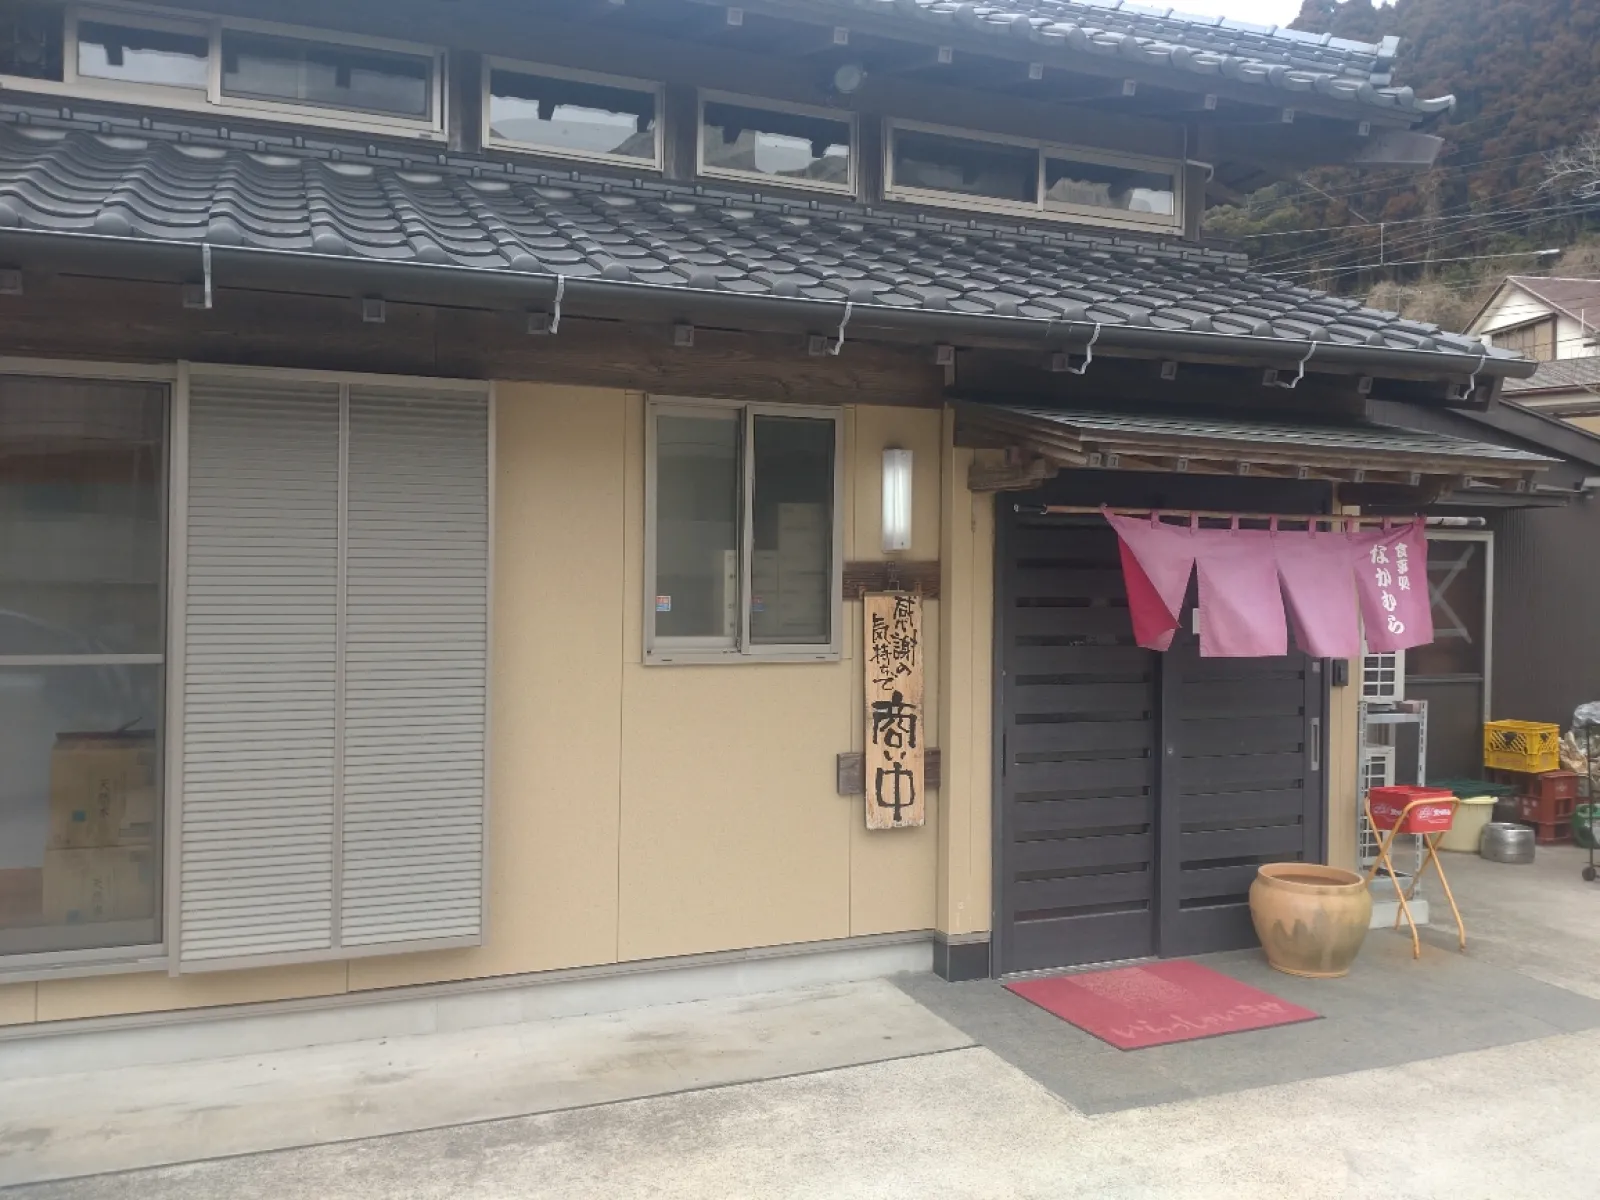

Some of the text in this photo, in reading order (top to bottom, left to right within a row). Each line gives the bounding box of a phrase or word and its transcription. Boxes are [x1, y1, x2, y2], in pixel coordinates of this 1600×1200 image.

[1394, 542, 1411, 591] 食事処
[869, 612, 898, 691] 気持ちで
[889, 595, 918, 676] 感謝の
[871, 690, 918, 822] 商い中
